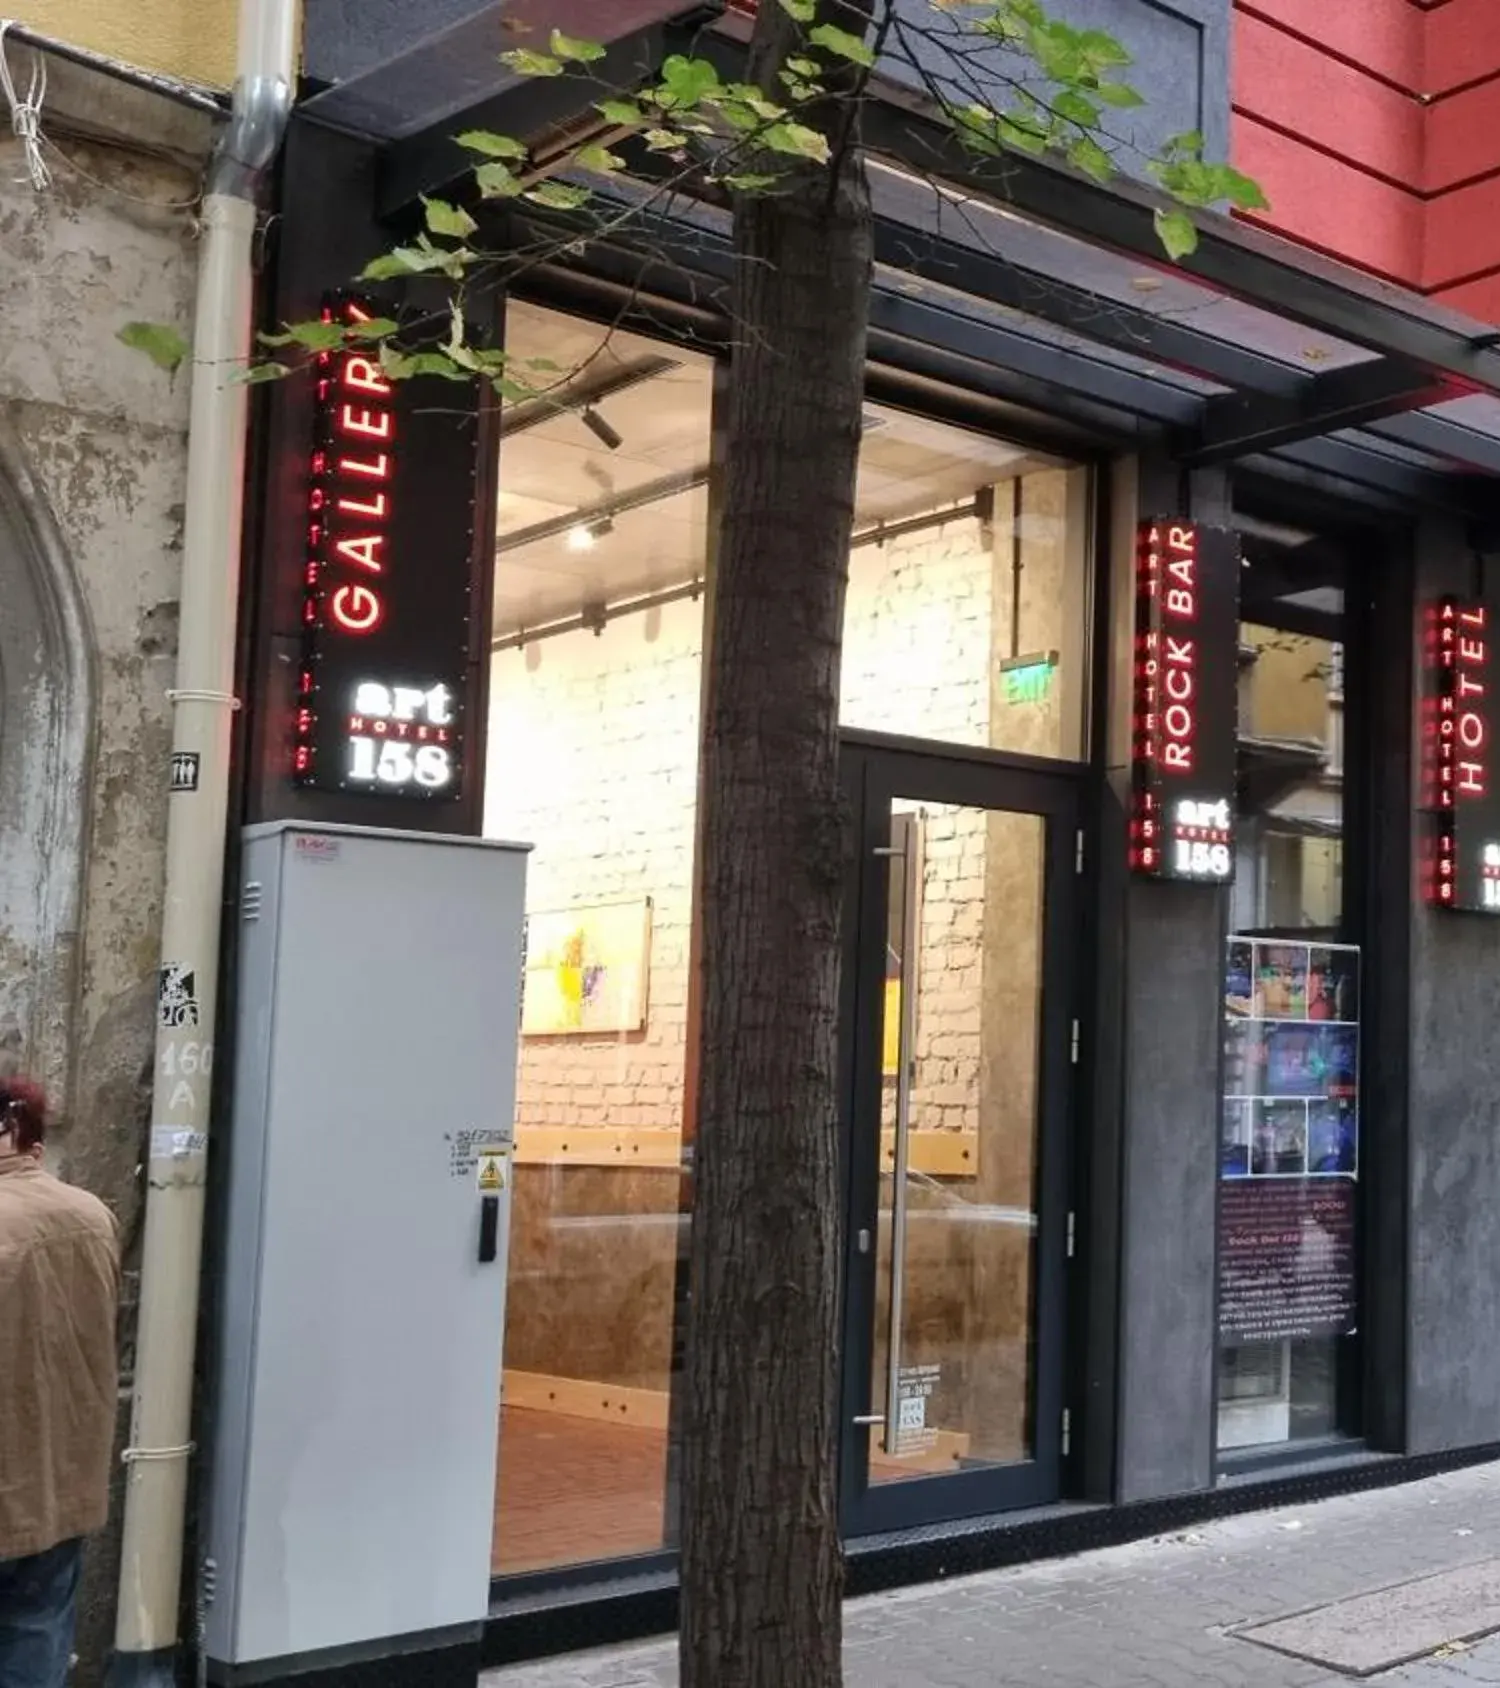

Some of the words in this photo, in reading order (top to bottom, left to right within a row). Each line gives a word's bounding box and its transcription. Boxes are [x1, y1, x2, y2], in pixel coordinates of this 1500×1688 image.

[1148, 527, 1160, 596] ART
[1167, 526, 1195, 615] BAR
[1442, 604, 1453, 667] ART
[355, 682, 452, 725] art
[1144, 632, 1159, 756] HOTEL
[1164, 637, 1193, 768] ROCK
[1459, 607, 1485, 791] HOTEL
[350, 716, 449, 742] HOTEL
[1440, 697, 1454, 806] HOTEL
[347, 735, 451, 787] 158
[1142, 793, 1154, 865] 158
[1177, 797, 1231, 830] art
[1175, 839, 1230, 876] 158
[160, 1041, 214, 1076] 160
[168, 1080, 196, 1111] A
